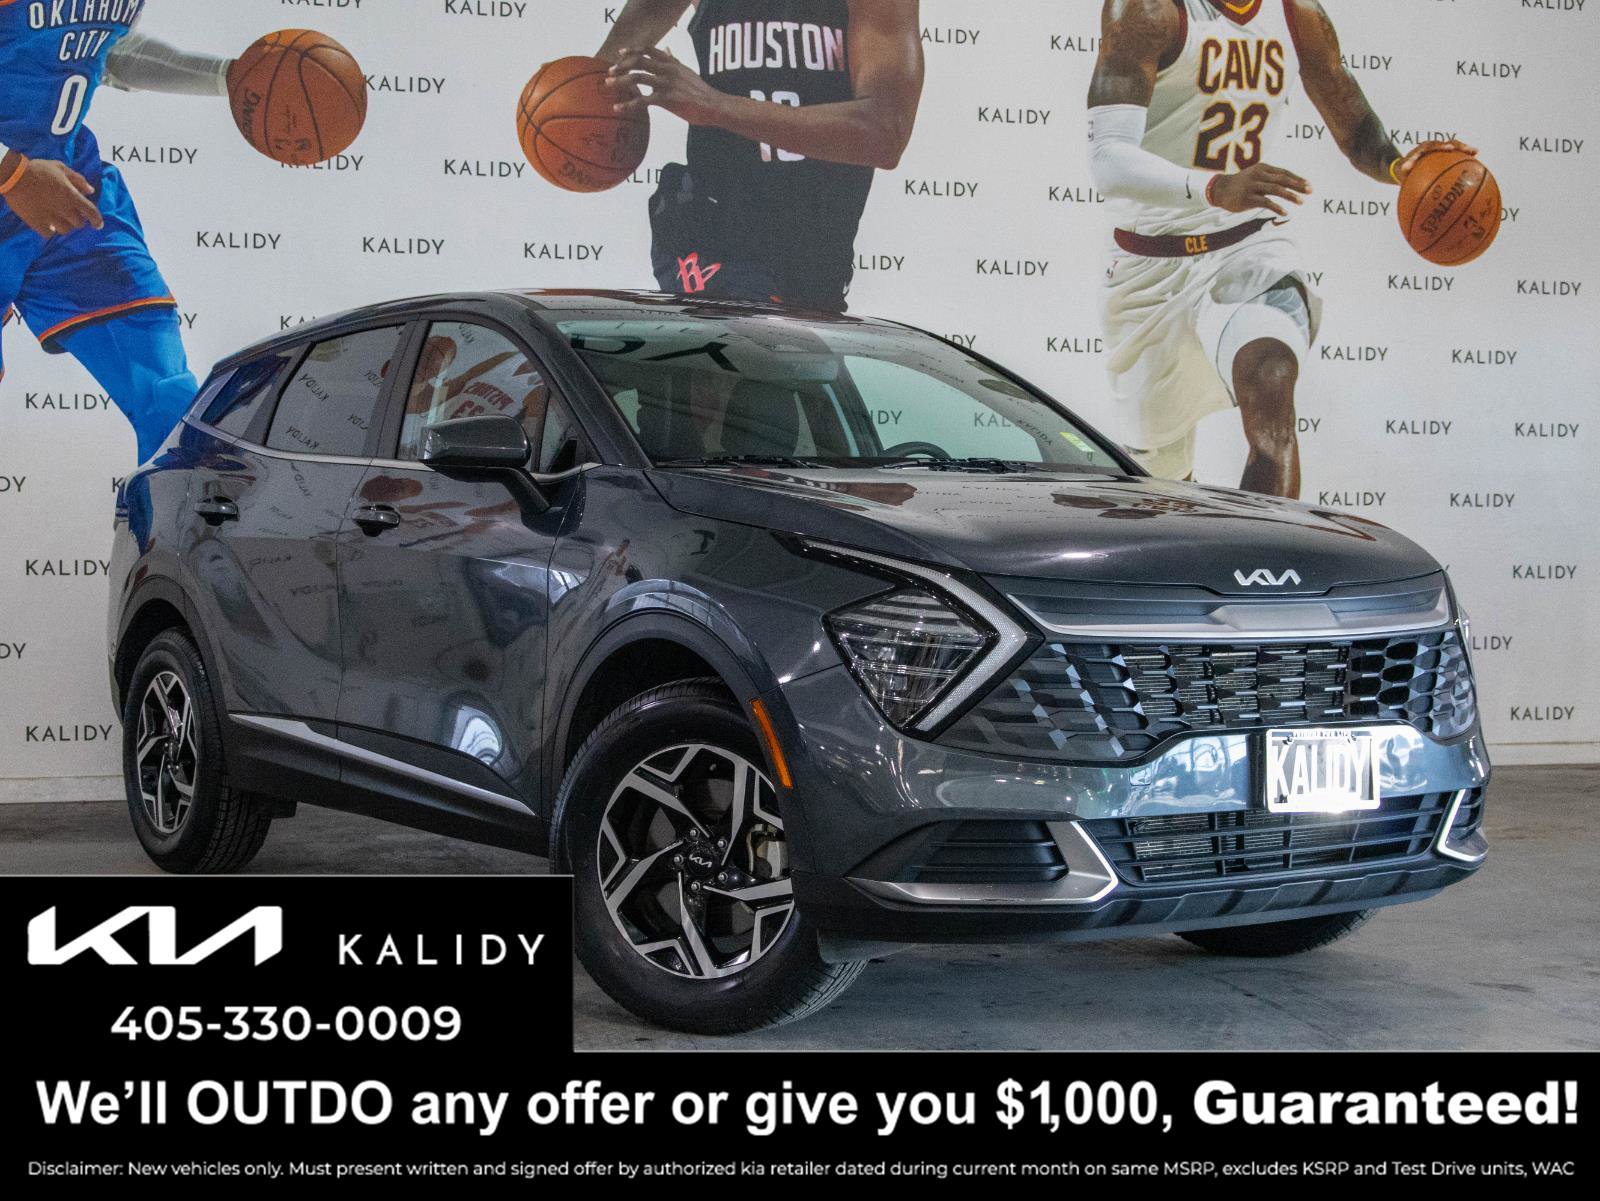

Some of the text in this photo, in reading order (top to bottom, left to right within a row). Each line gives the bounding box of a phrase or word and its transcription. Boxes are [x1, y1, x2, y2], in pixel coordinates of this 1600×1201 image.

[29, 0, 140, 29] OKLAHOM
[445, 0, 526, 18] KALIDY
[920, 27, 980, 45] ALIDY
[1051, 35, 1102, 52] KALI
[59, 30, 111, 61] CITY
[709, 21, 845, 75] HOUSTON
[1197, 38, 1284, 96] CAVS
[1341, 54, 1392, 70] ALIDY
[1457, 61, 1521, 78] KALIDY
[364, 75, 445, 94] KALIDY
[51, 74, 88, 135] 0
[978, 107, 1050, 125] KALIDY
[1193, 101, 1270, 171] 23
[1286, 124, 1326, 140] IDY
[1391, 130, 1457, 145] KALIDY
[1520, 137, 1584, 153] KALIDY
[112, 146, 198, 164] KALIDY
[444, 159, 526, 178] KALIDY
[905, 180, 978, 197] KALIDY
[1324, 200, 1390, 216] KALIDY
[197, 231, 281, 250] KALIDY
[363, 237, 444, 254] KALIDY
[1185, 236, 1208, 253] CLE
[524, 243, 604, 260] KALIDY
[852, 256, 904, 271] LIDY
[977, 259, 1049, 276] KALIDY
[1388, 275, 1454, 291] KALIDY
[1517, 280, 1582, 295] KALIDY
[1047, 337, 1103, 353] KALID
[1321, 346, 1388, 361] KALIDY
[1452, 349, 1517, 365] KALIDY
[26, 393, 111, 410] KALIDY
[1386, 420, 1452, 435] KALIDY
[1515, 423, 1580, 438] KALIDY
[1319, 492, 1386, 506] KALIDY
[1450, 493, 1515, 508] KALIDY
[26, 560, 111, 576] KALIDY
[1513, 565, 1577, 579] KALIDY
[1473, 636, 1513, 650] LIDY
[1511, 706, 1575, 720] KALIDY
[26, 725, 113, 742] KALIDY
[1271, 742, 1369, 801] KALIDY
